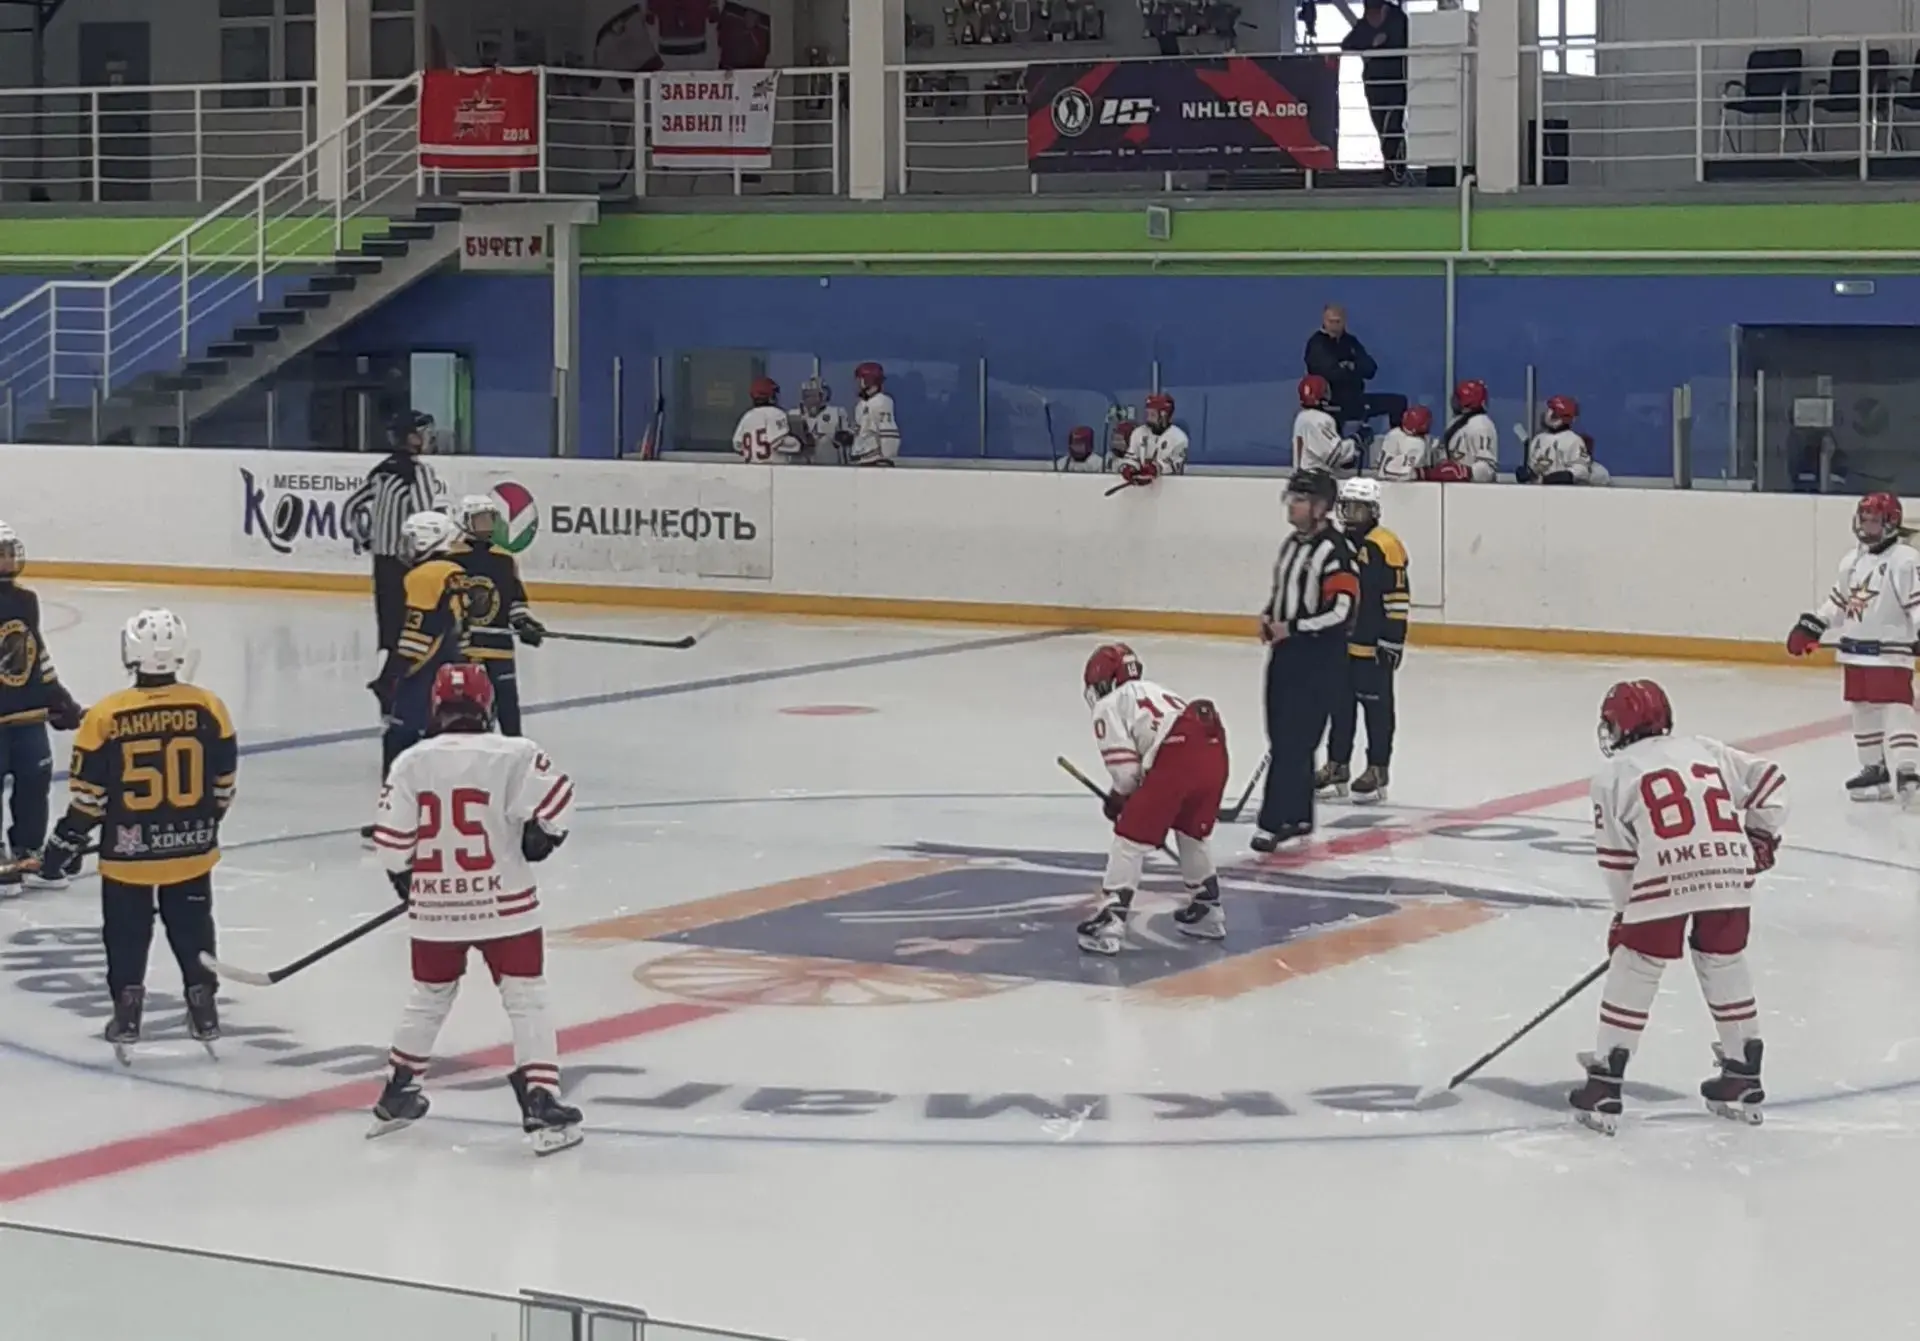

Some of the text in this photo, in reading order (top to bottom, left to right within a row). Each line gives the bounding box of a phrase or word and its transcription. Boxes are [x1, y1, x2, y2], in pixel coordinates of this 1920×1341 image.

[662, 115, 722, 132] ЗАБИЛ
[1182, 100, 1308, 118] NHLIGA.ORG
[466, 236, 524, 257] БУФЕТ
[740, 427, 772, 463] 95
[551, 505, 757, 541] БАШНЕФТЬ
[121, 736, 204, 811] 50
[1640, 763, 1743, 839] 82
[412, 788, 495, 873] 25
[1657, 842, 1749, 866] ИЖЕВСК
[409, 875, 502, 894] ИЖЕВСК
